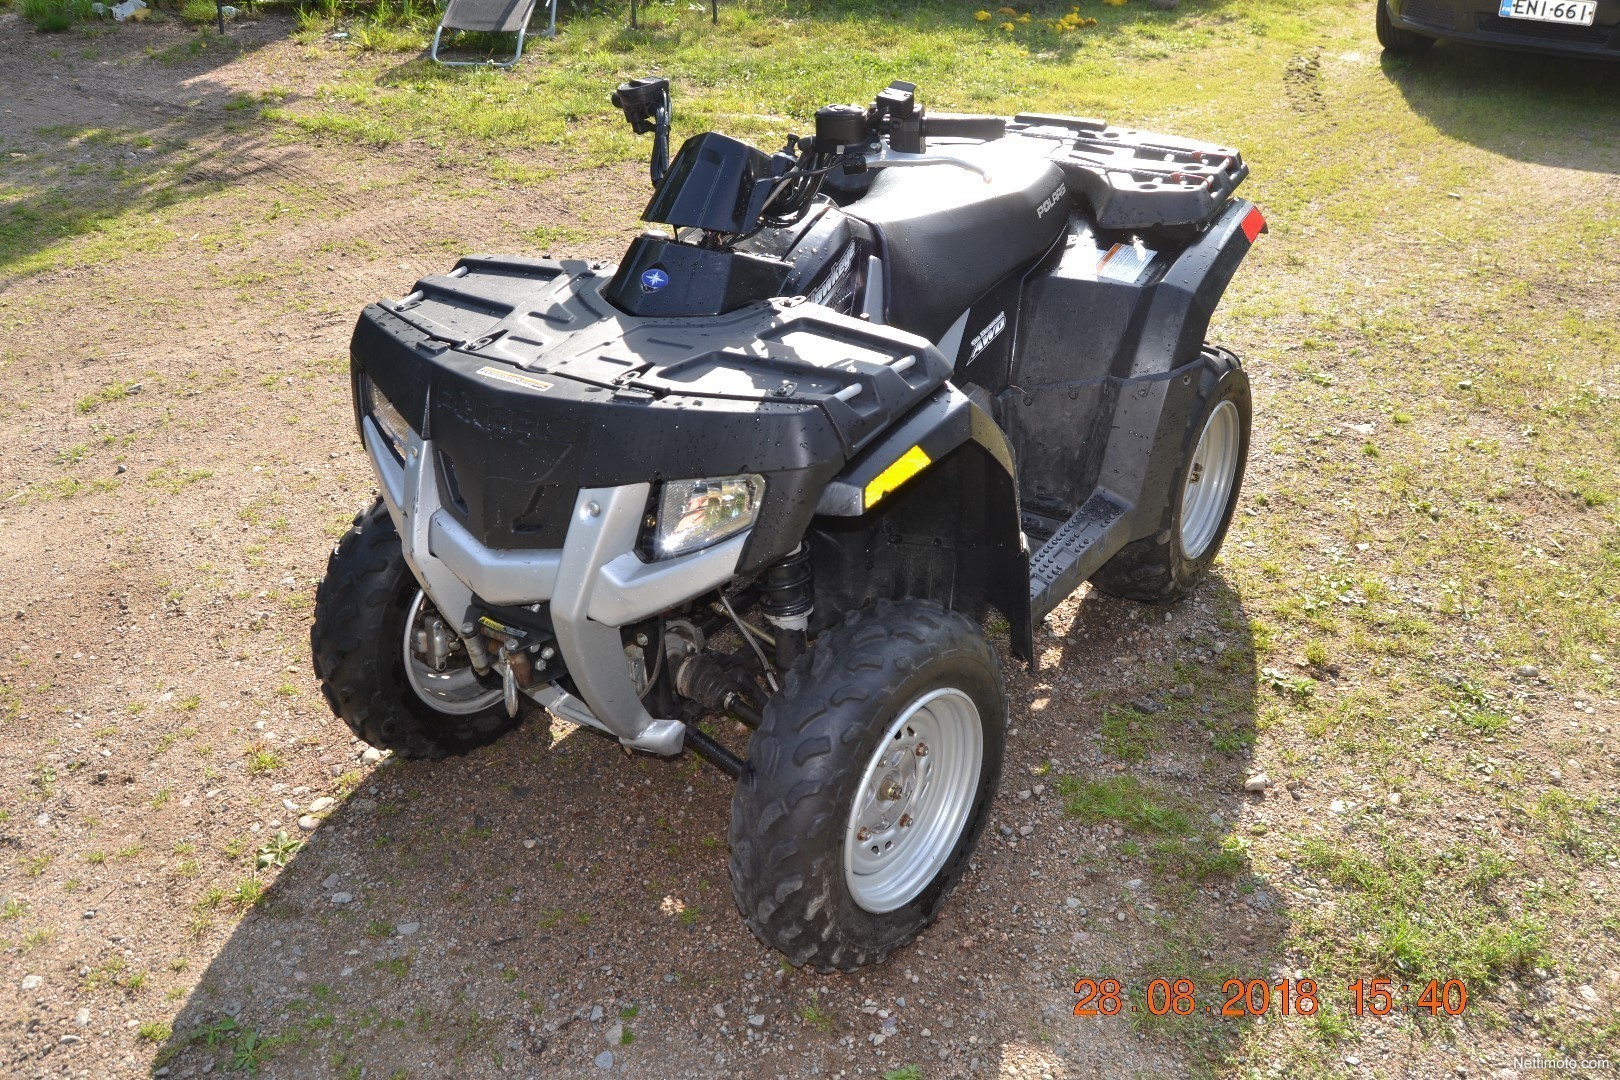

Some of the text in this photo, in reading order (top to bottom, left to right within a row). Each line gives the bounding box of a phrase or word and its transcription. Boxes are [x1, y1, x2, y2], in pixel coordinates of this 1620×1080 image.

[1513, 0, 1587, 20] ENI-661
[1037, 182, 1066, 218] POLARIS
[970, 316, 1006, 359] AWD
